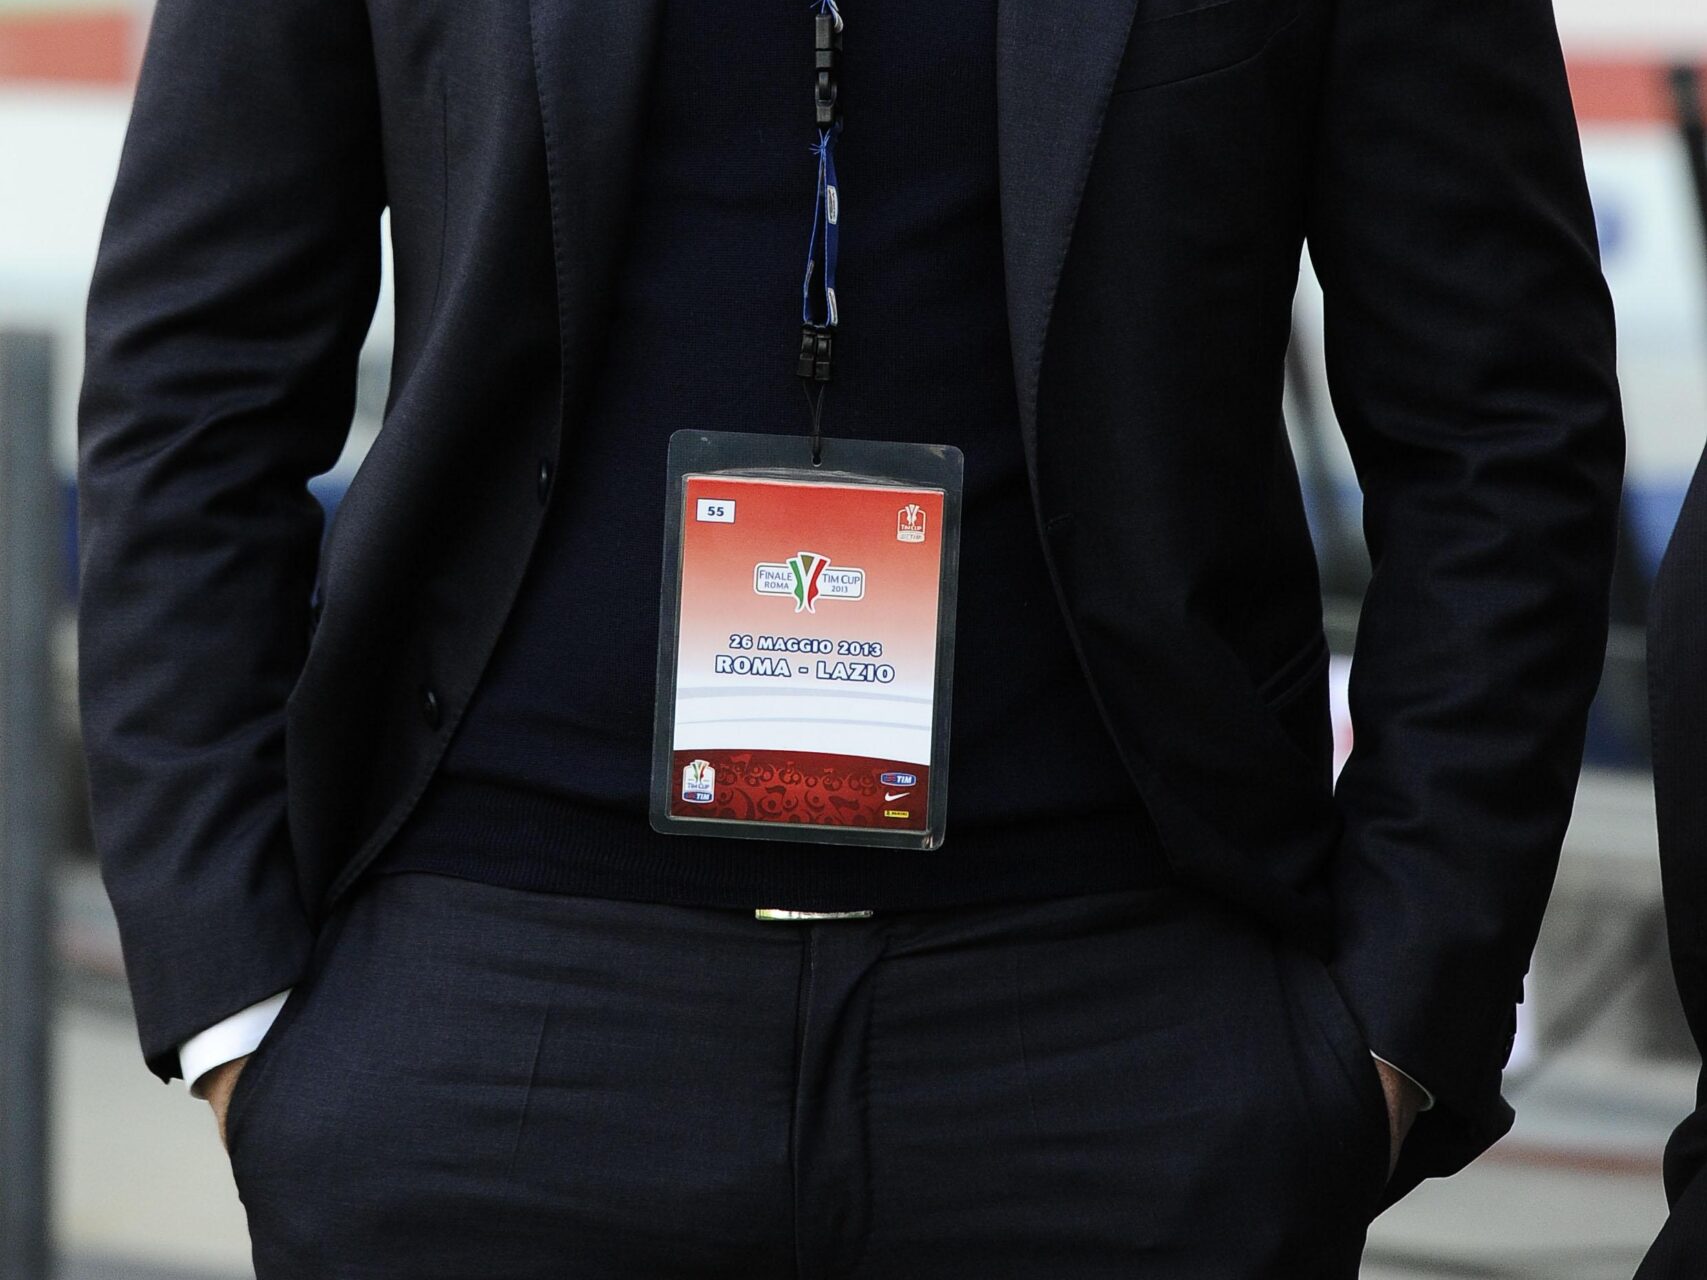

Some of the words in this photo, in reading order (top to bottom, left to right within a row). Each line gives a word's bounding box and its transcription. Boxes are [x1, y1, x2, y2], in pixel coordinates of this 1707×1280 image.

[707, 505, 725, 518] 55
[759, 570, 793, 581] FINALE
[822, 573, 839, 584] TIM
[840, 575, 861, 585] CUP
[764, 581, 789, 590] ROMA
[831, 585, 849, 593] 2013
[729, 634, 753, 650] 26
[757, 636, 833, 654] MAGGIO
[838, 640, 883, 657] 2013
[715, 655, 792, 678] ROMA
[816, 660, 895, 684] LAZIO
[896, 775, 912, 784] TIM
